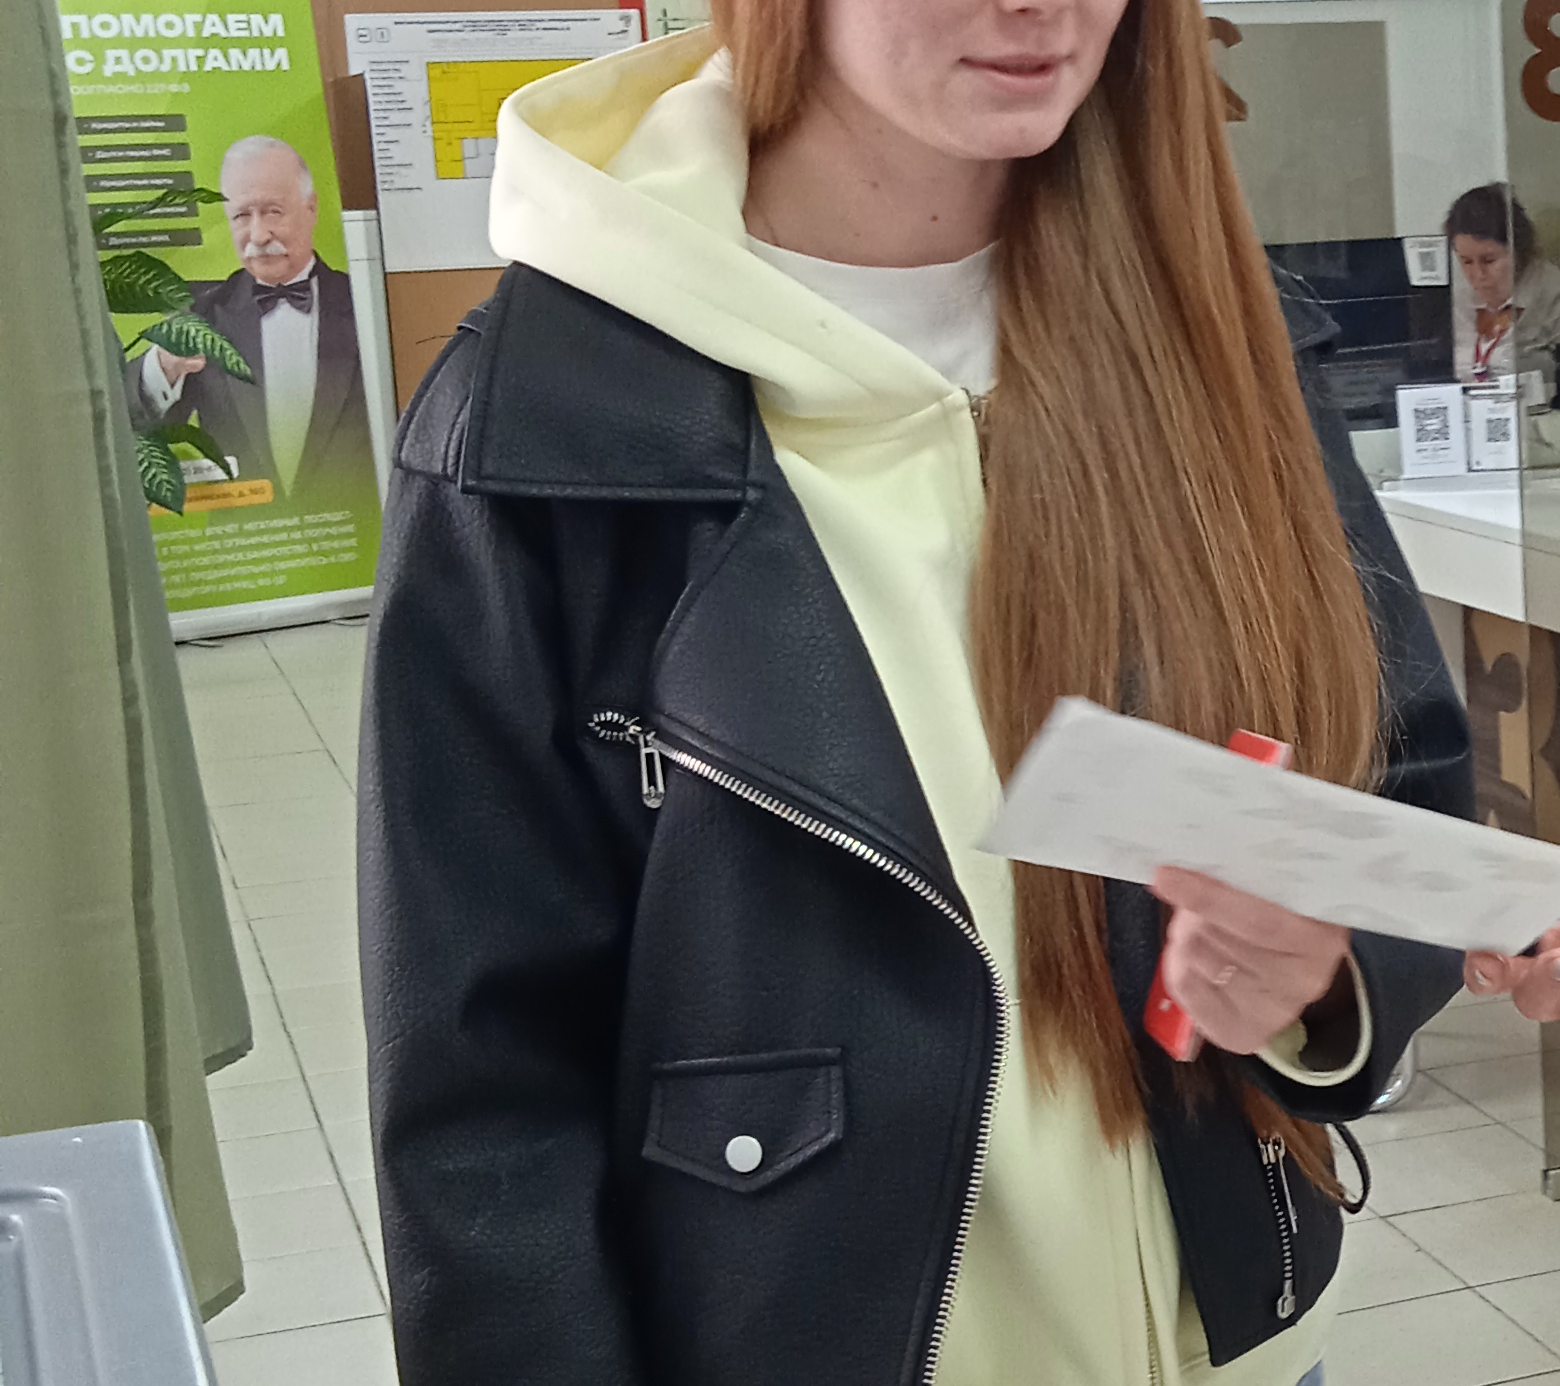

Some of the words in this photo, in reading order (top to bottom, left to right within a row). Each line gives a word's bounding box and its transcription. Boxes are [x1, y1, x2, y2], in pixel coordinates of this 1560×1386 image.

[60, 13, 285, 39] ПОМОГАЕМ
[65, 50, 95, 74] С
[102, 48, 290, 77] ДОЛГАМИ
